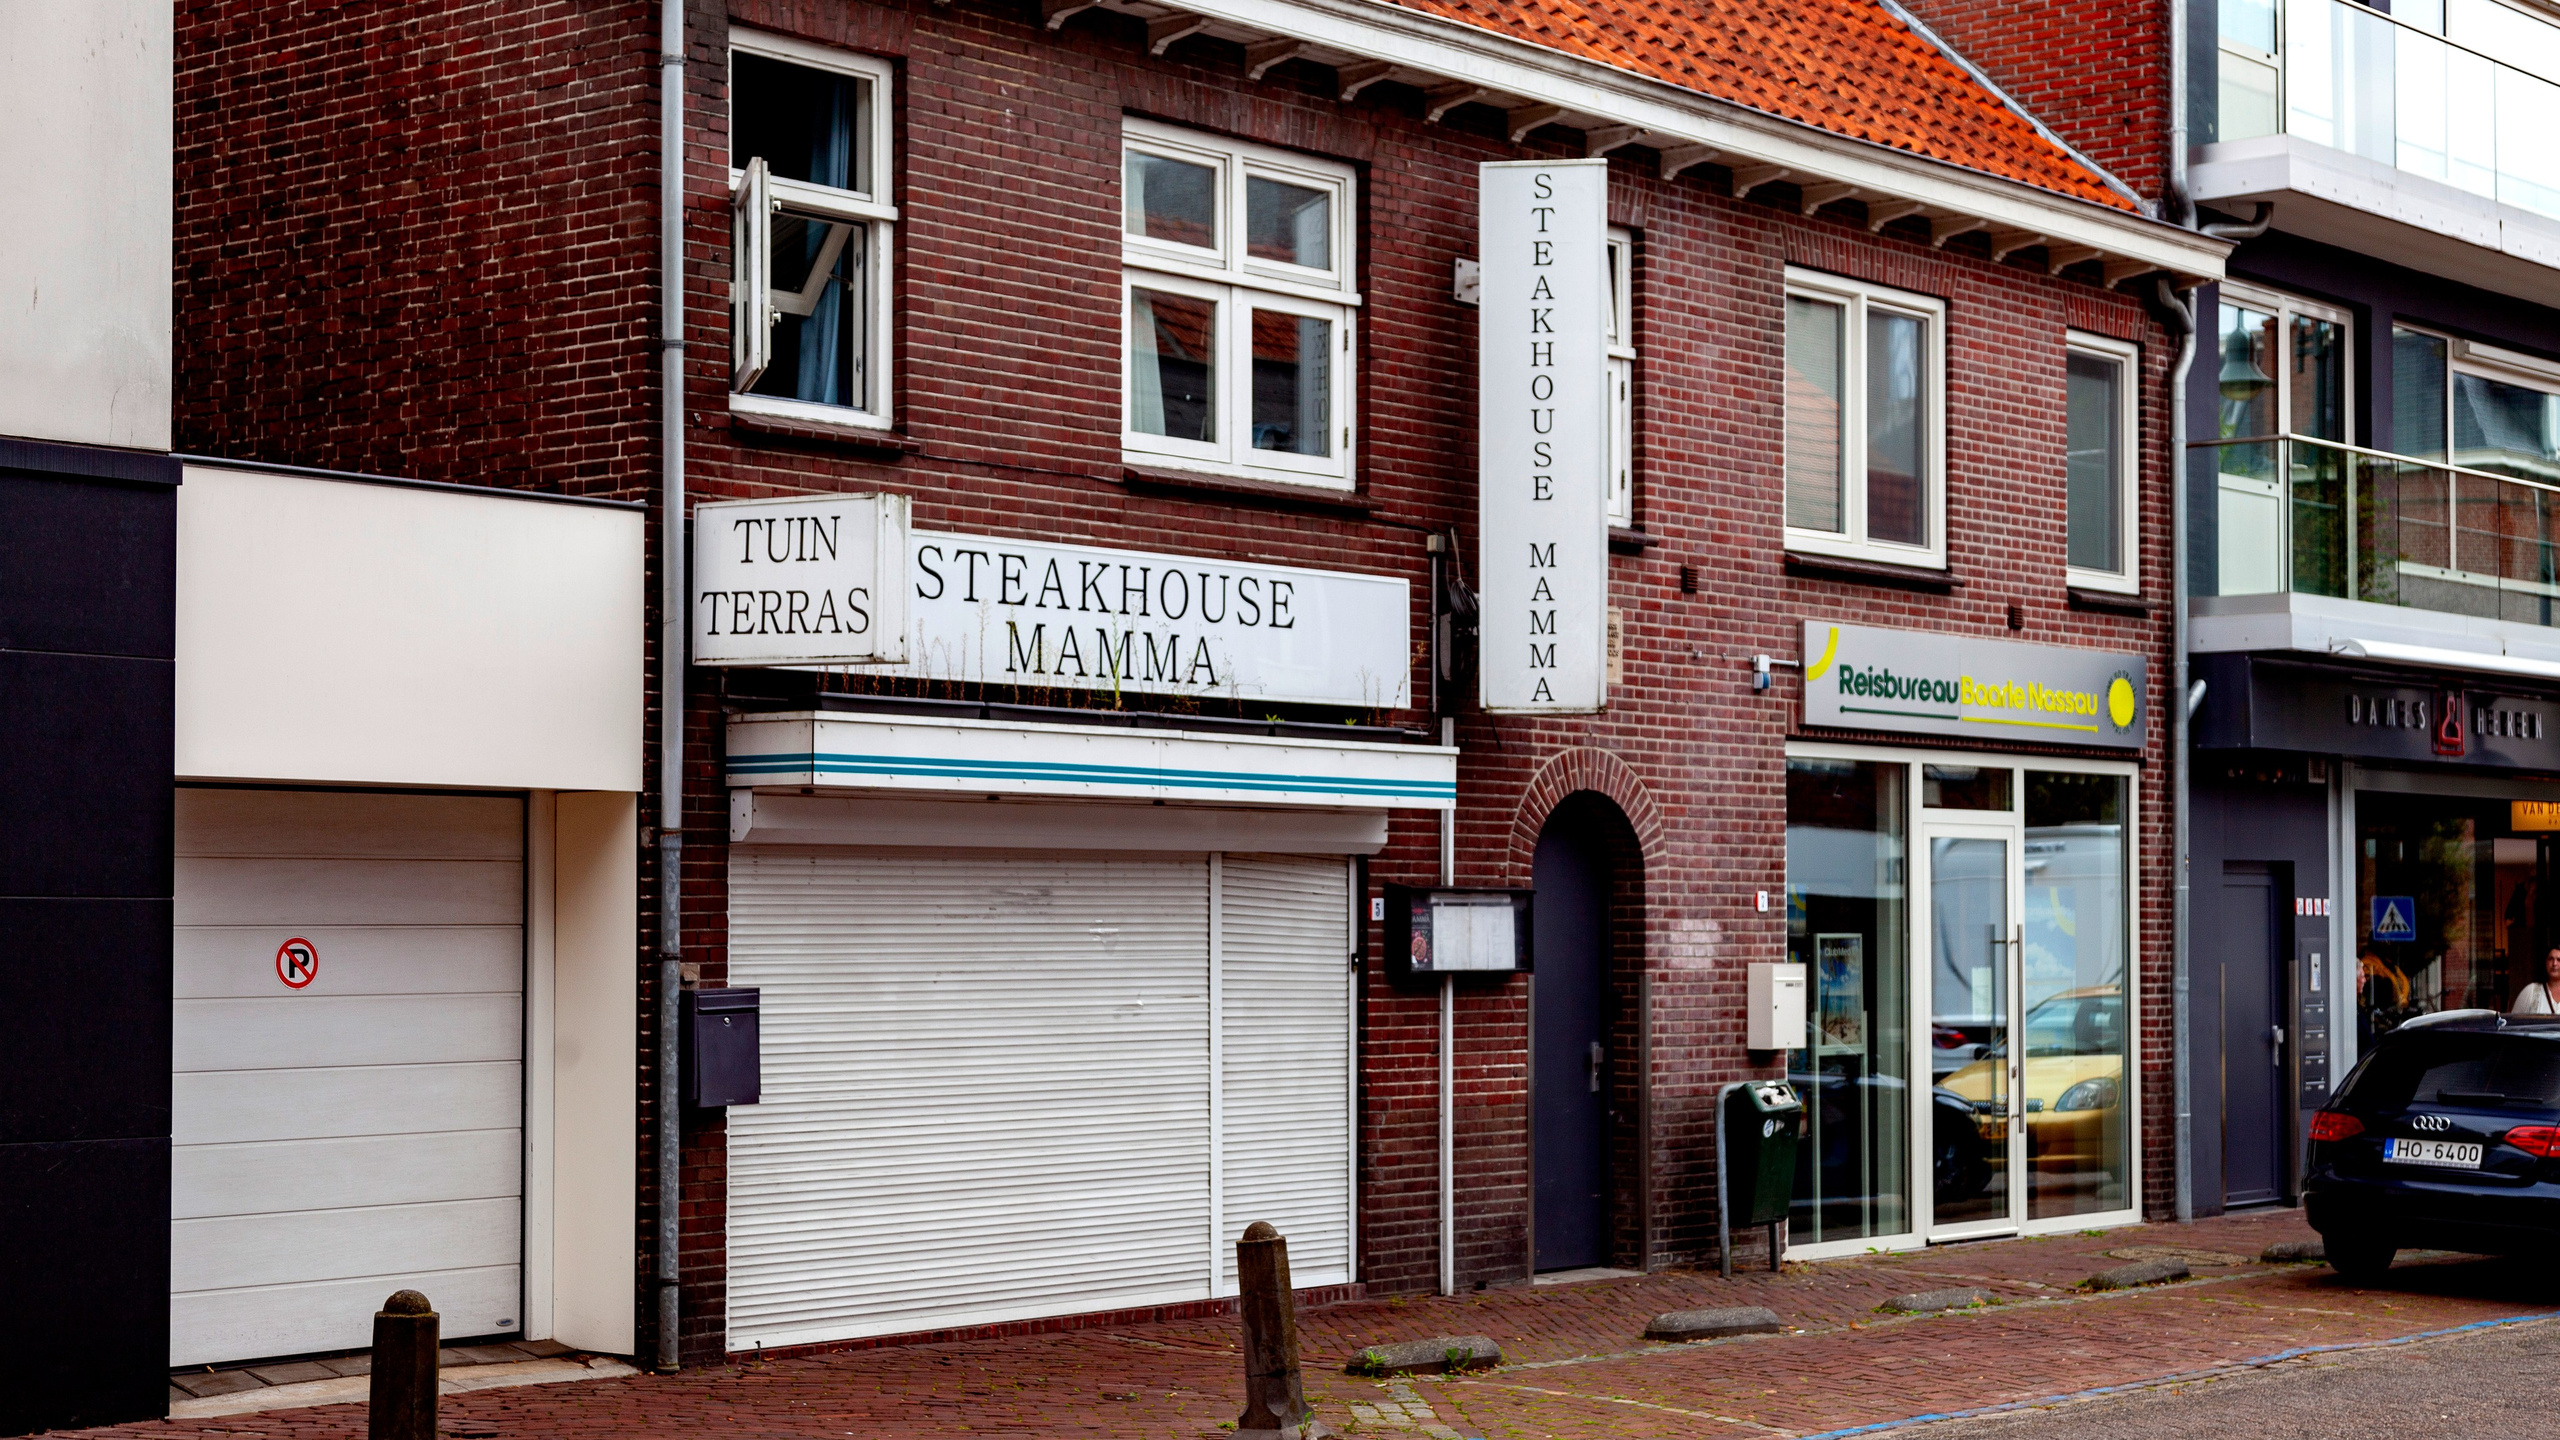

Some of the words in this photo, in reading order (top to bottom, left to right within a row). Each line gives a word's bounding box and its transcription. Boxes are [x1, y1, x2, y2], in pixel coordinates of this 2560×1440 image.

[1530, 173, 1556, 501] STEAKHOUSE
[733, 515, 841, 563] TUIN
[700, 587, 869, 636] TERRAS
[916, 546, 1295, 630] STEAKHOUSE
[1529, 542, 1558, 703] MAMMA
[1006, 620, 1219, 686] MAMMA
[1839, 664, 1959, 702] Reisbureau
[1961, 675, 2025, 709] Baarle
[2028, 682, 2099, 717] Nassau
[2352, 695, 2426, 730] DAMES
[2477, 707, 2543, 740] HEREN
[2523, 801, 2544, 815] VAN
[1375, 902, 1381, 917] 5
